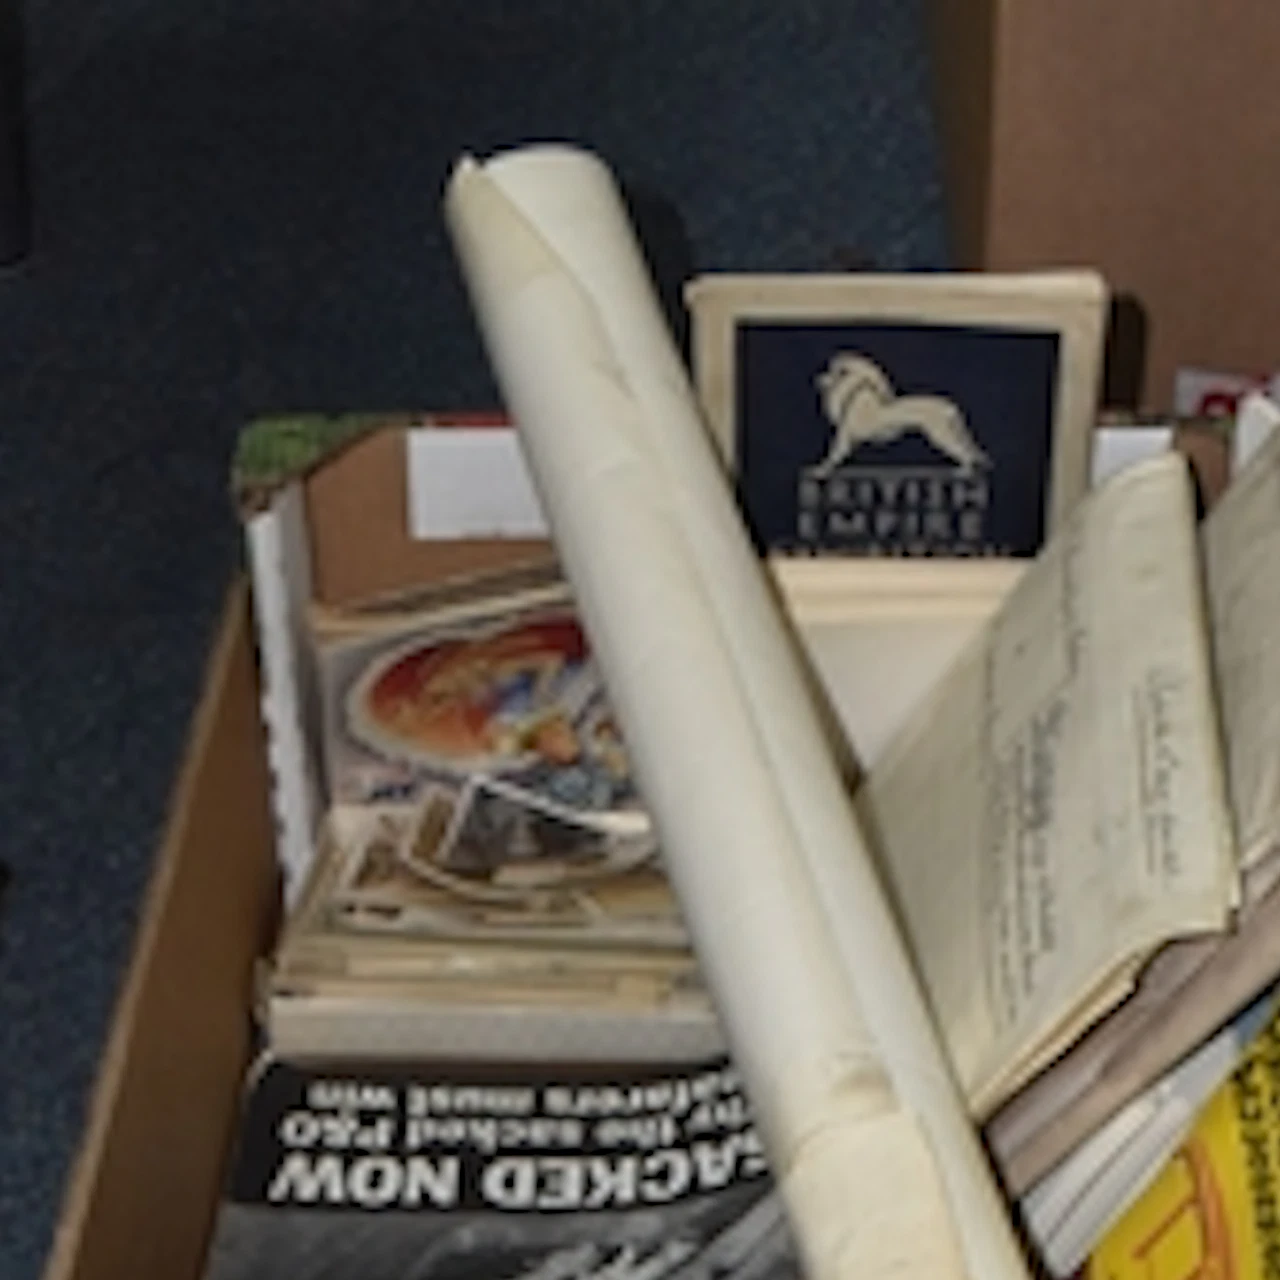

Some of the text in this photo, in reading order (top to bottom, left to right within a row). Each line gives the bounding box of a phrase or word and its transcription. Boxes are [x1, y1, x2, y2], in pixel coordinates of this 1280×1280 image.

[307, 1082, 396, 1113] win
[407, 1084, 535, 1115] must
[280, 1112, 391, 1149] P&O
[407, 1113, 584, 1152] sacked
[596, 1112, 675, 1148] the
[268, 1154, 460, 1204] NOW
